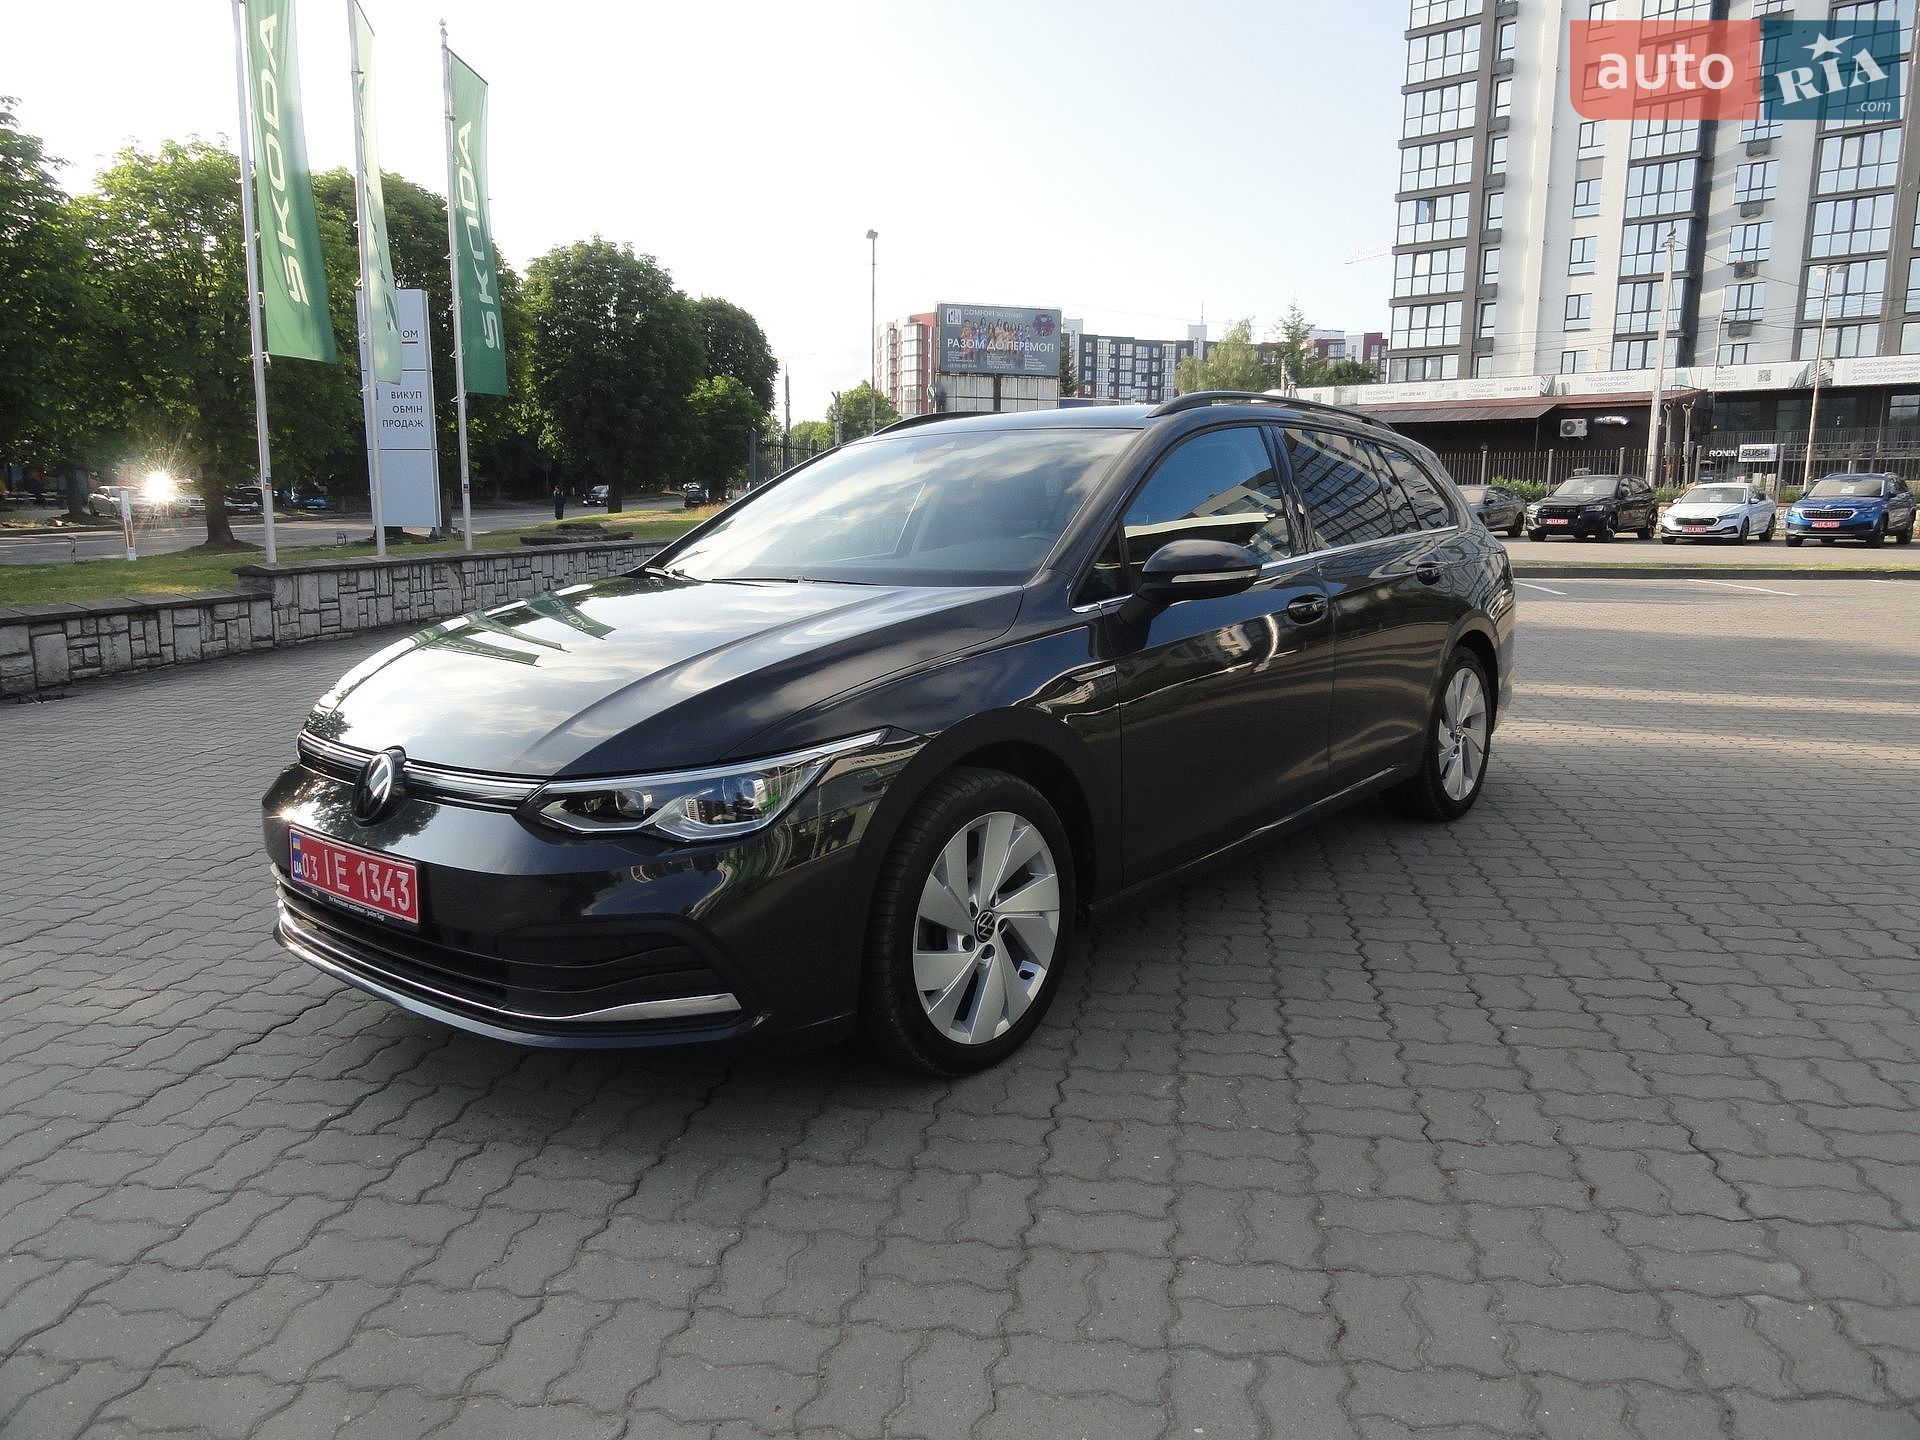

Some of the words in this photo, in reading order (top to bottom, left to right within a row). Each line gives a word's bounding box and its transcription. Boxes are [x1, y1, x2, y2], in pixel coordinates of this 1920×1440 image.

[947, 338, 985, 349] РАЗОМ
[986, 340, 1006, 351] ДО
[1006, 341, 1054, 353] ПЕРЕМОГ!
[391, 391, 422, 400] ВИКУП
[392, 405, 423, 414] ОБМІН
[382, 419, 424, 428] ПРОДАЖ
[1708, 449, 1738, 457] RONIN
[293, 860, 303, 876] UA
[302, 852, 318, 881] 03
[323, 848, 350, 893] IE
[356, 861, 410, 912] 1343
